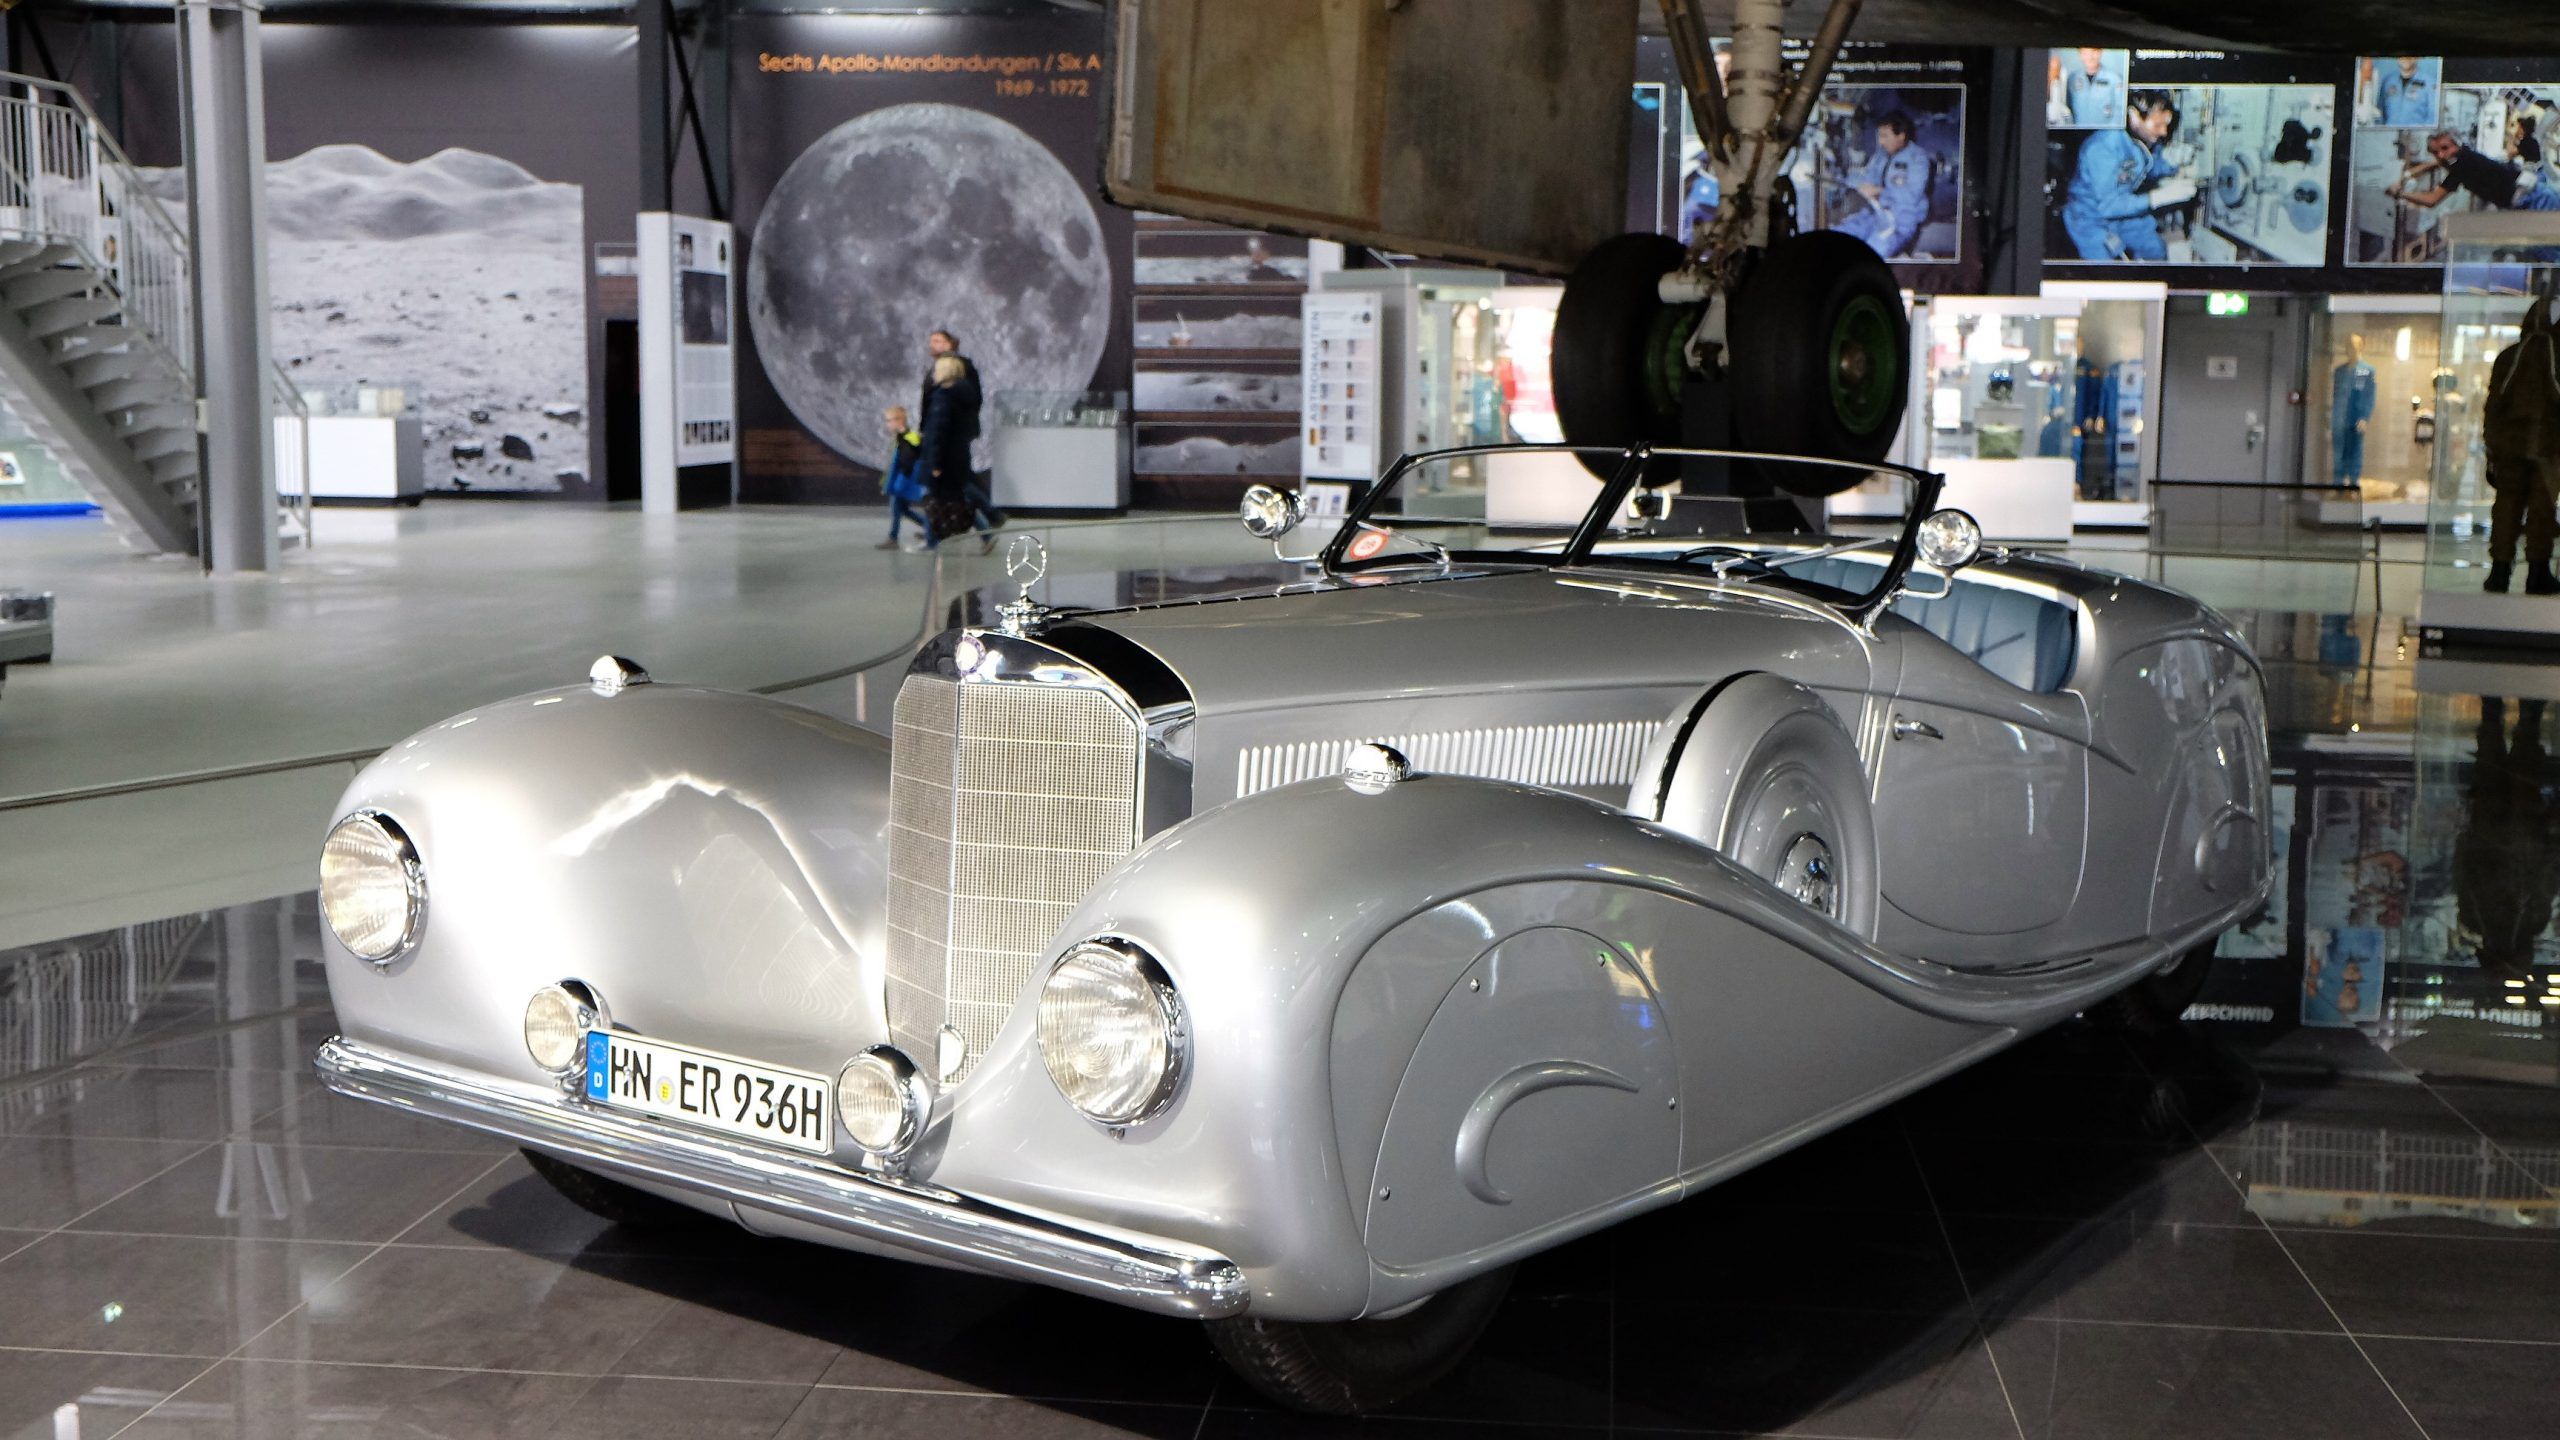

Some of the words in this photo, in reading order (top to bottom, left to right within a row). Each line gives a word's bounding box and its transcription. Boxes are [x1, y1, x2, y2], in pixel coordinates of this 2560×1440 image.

[759, 52, 814, 73] Sechs
[817, 52, 1040, 77] Apollo-Mondlandungen
[1044, 53, 1055, 72] /
[1057, 52, 1082, 72] Six
[1087, 53, 1101, 71] A
[996, 79, 1034, 97] 1969
[1051, 79, 1090, 97] 1972
[1310, 311, 1320, 422] ASTRONAUTEN
[612, 1046, 651, 1102] HN
[680, 1061, 720, 1118] ER
[734, 1074, 823, 1141] 936H
